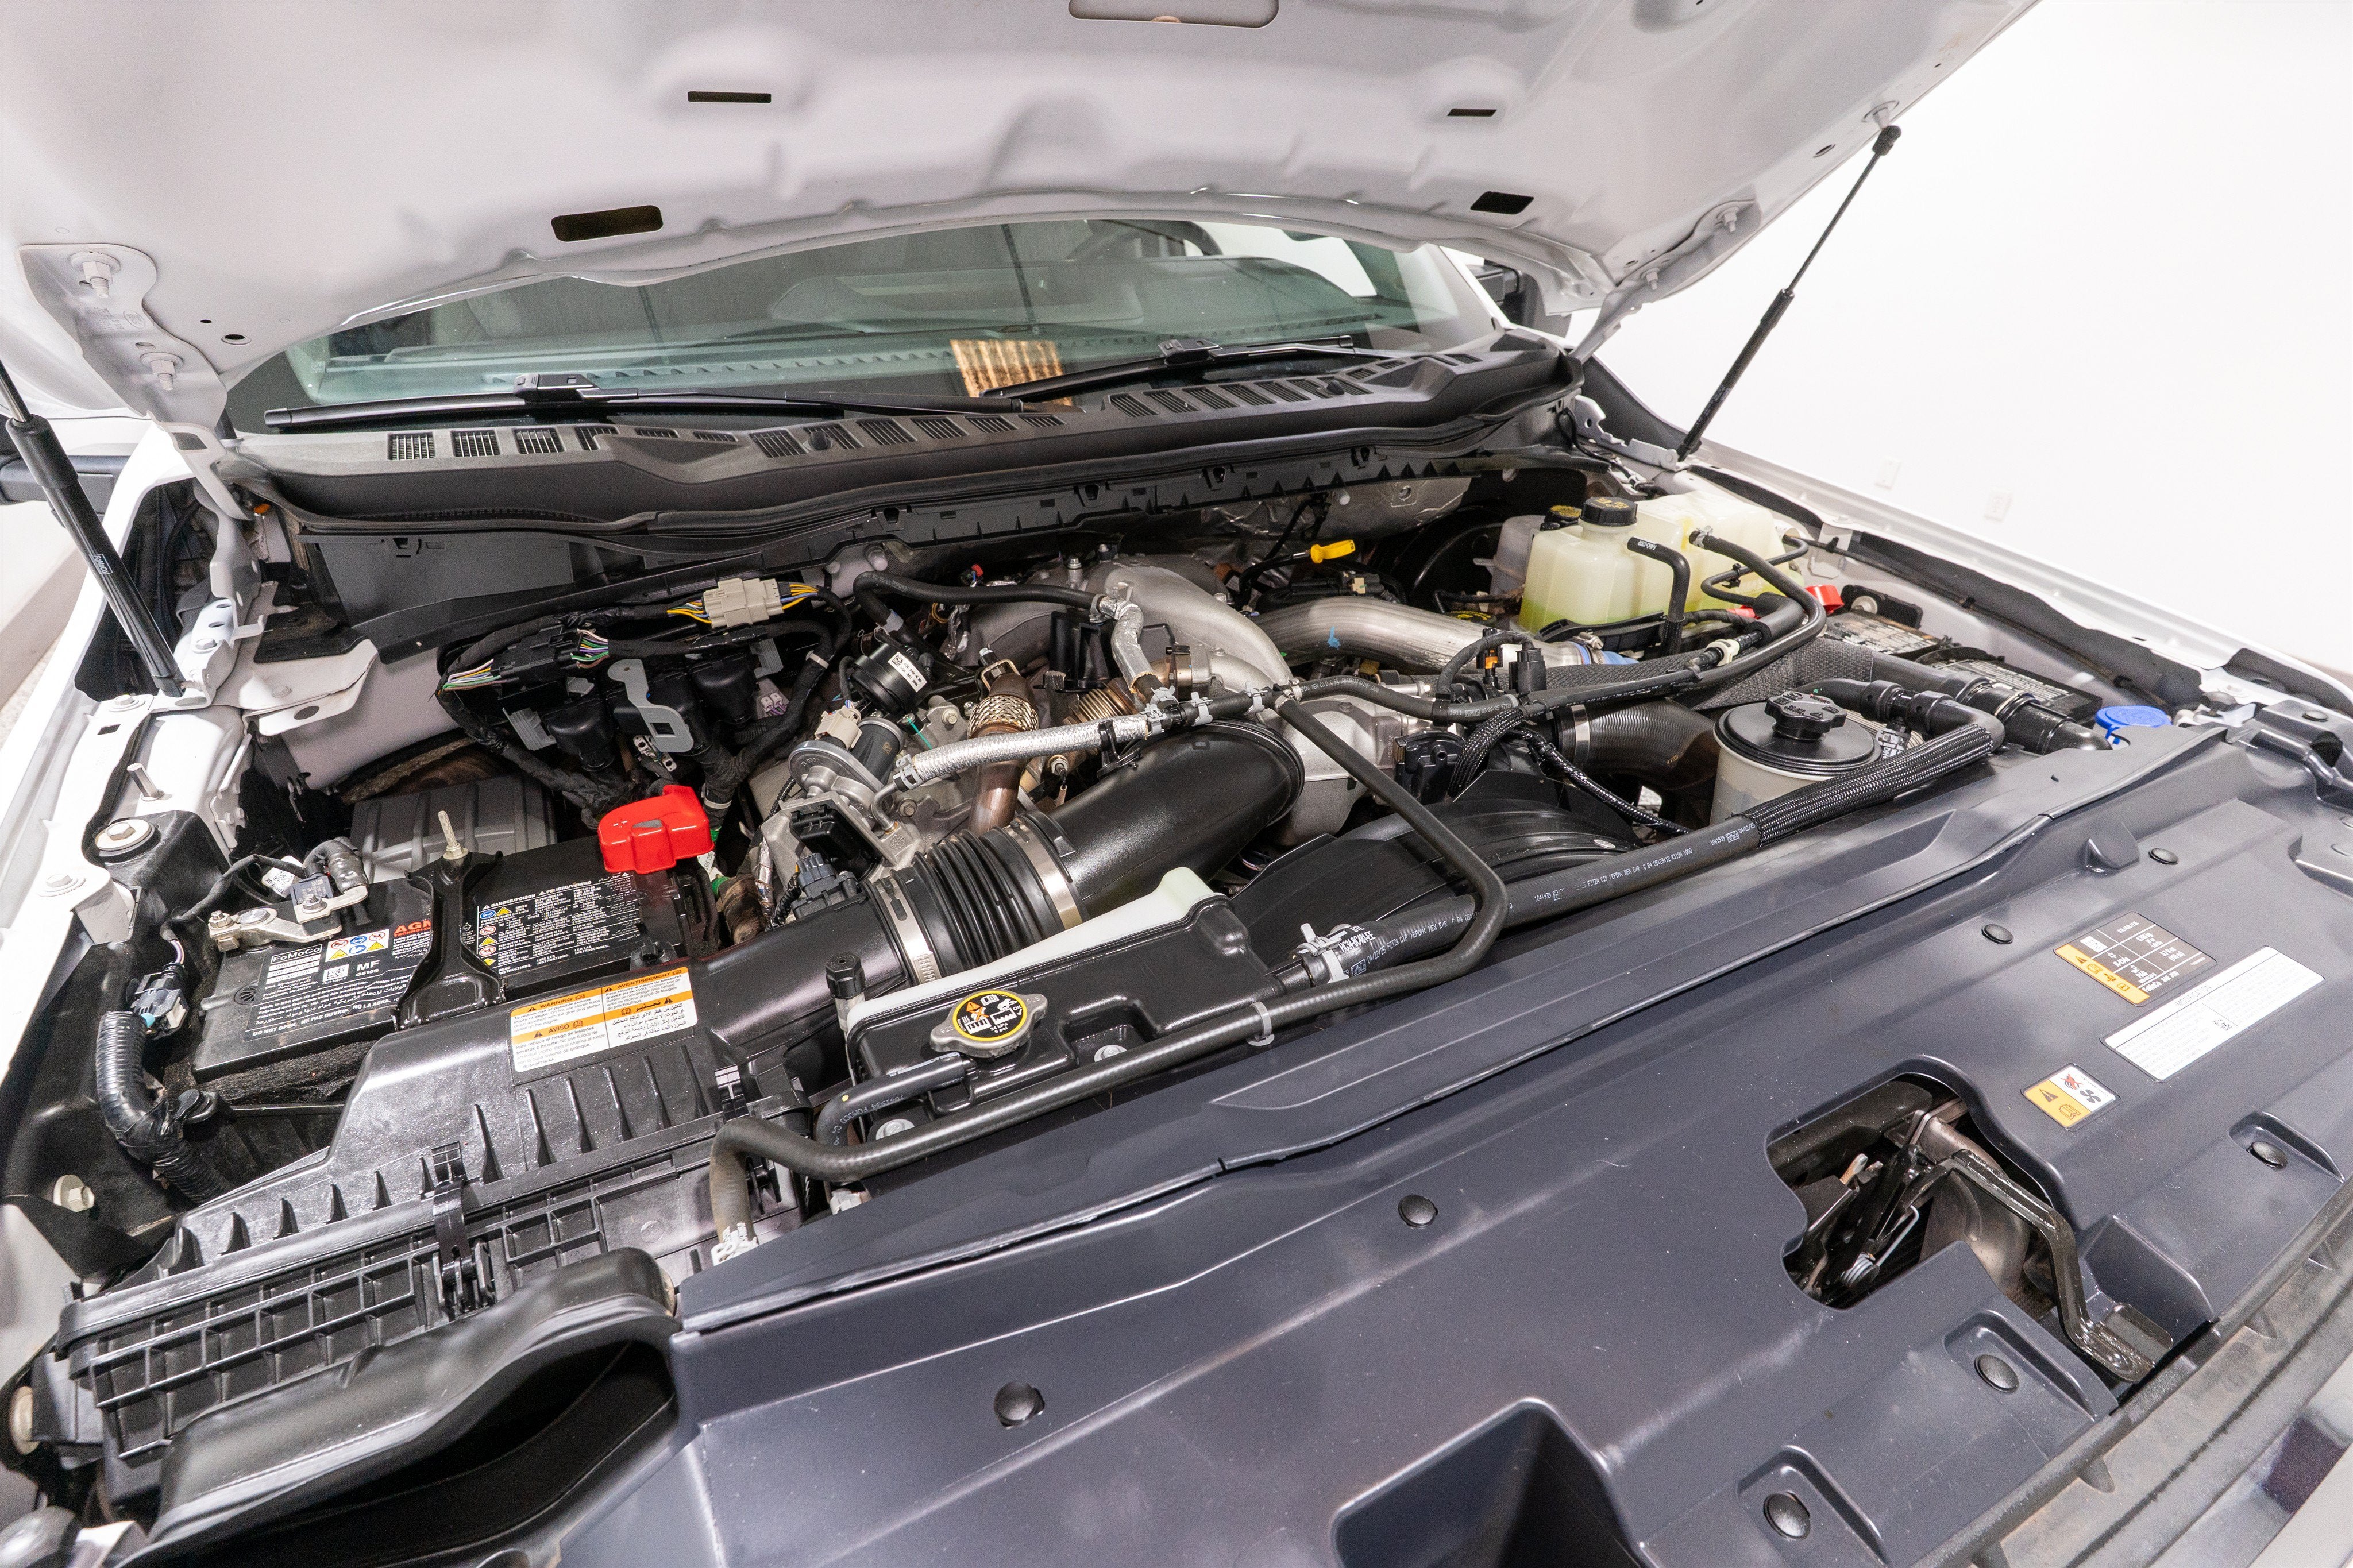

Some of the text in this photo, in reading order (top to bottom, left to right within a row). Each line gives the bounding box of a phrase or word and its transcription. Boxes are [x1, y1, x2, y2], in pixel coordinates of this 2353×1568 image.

[491, 881, 592, 907] DANGER/POISON PELIGRO/VENENO
[273, 947, 320, 963] FoMoCo
[357, 959, 380, 972] MF
[617, 972, 671, 988] AVERTISSEMENT
[351, 1003, 362, 1011] NO
[372, 997, 391, 1006] ABRA.
[539, 997, 572, 1008] WARNING
[548, 1023, 569, 1033] AVISO
